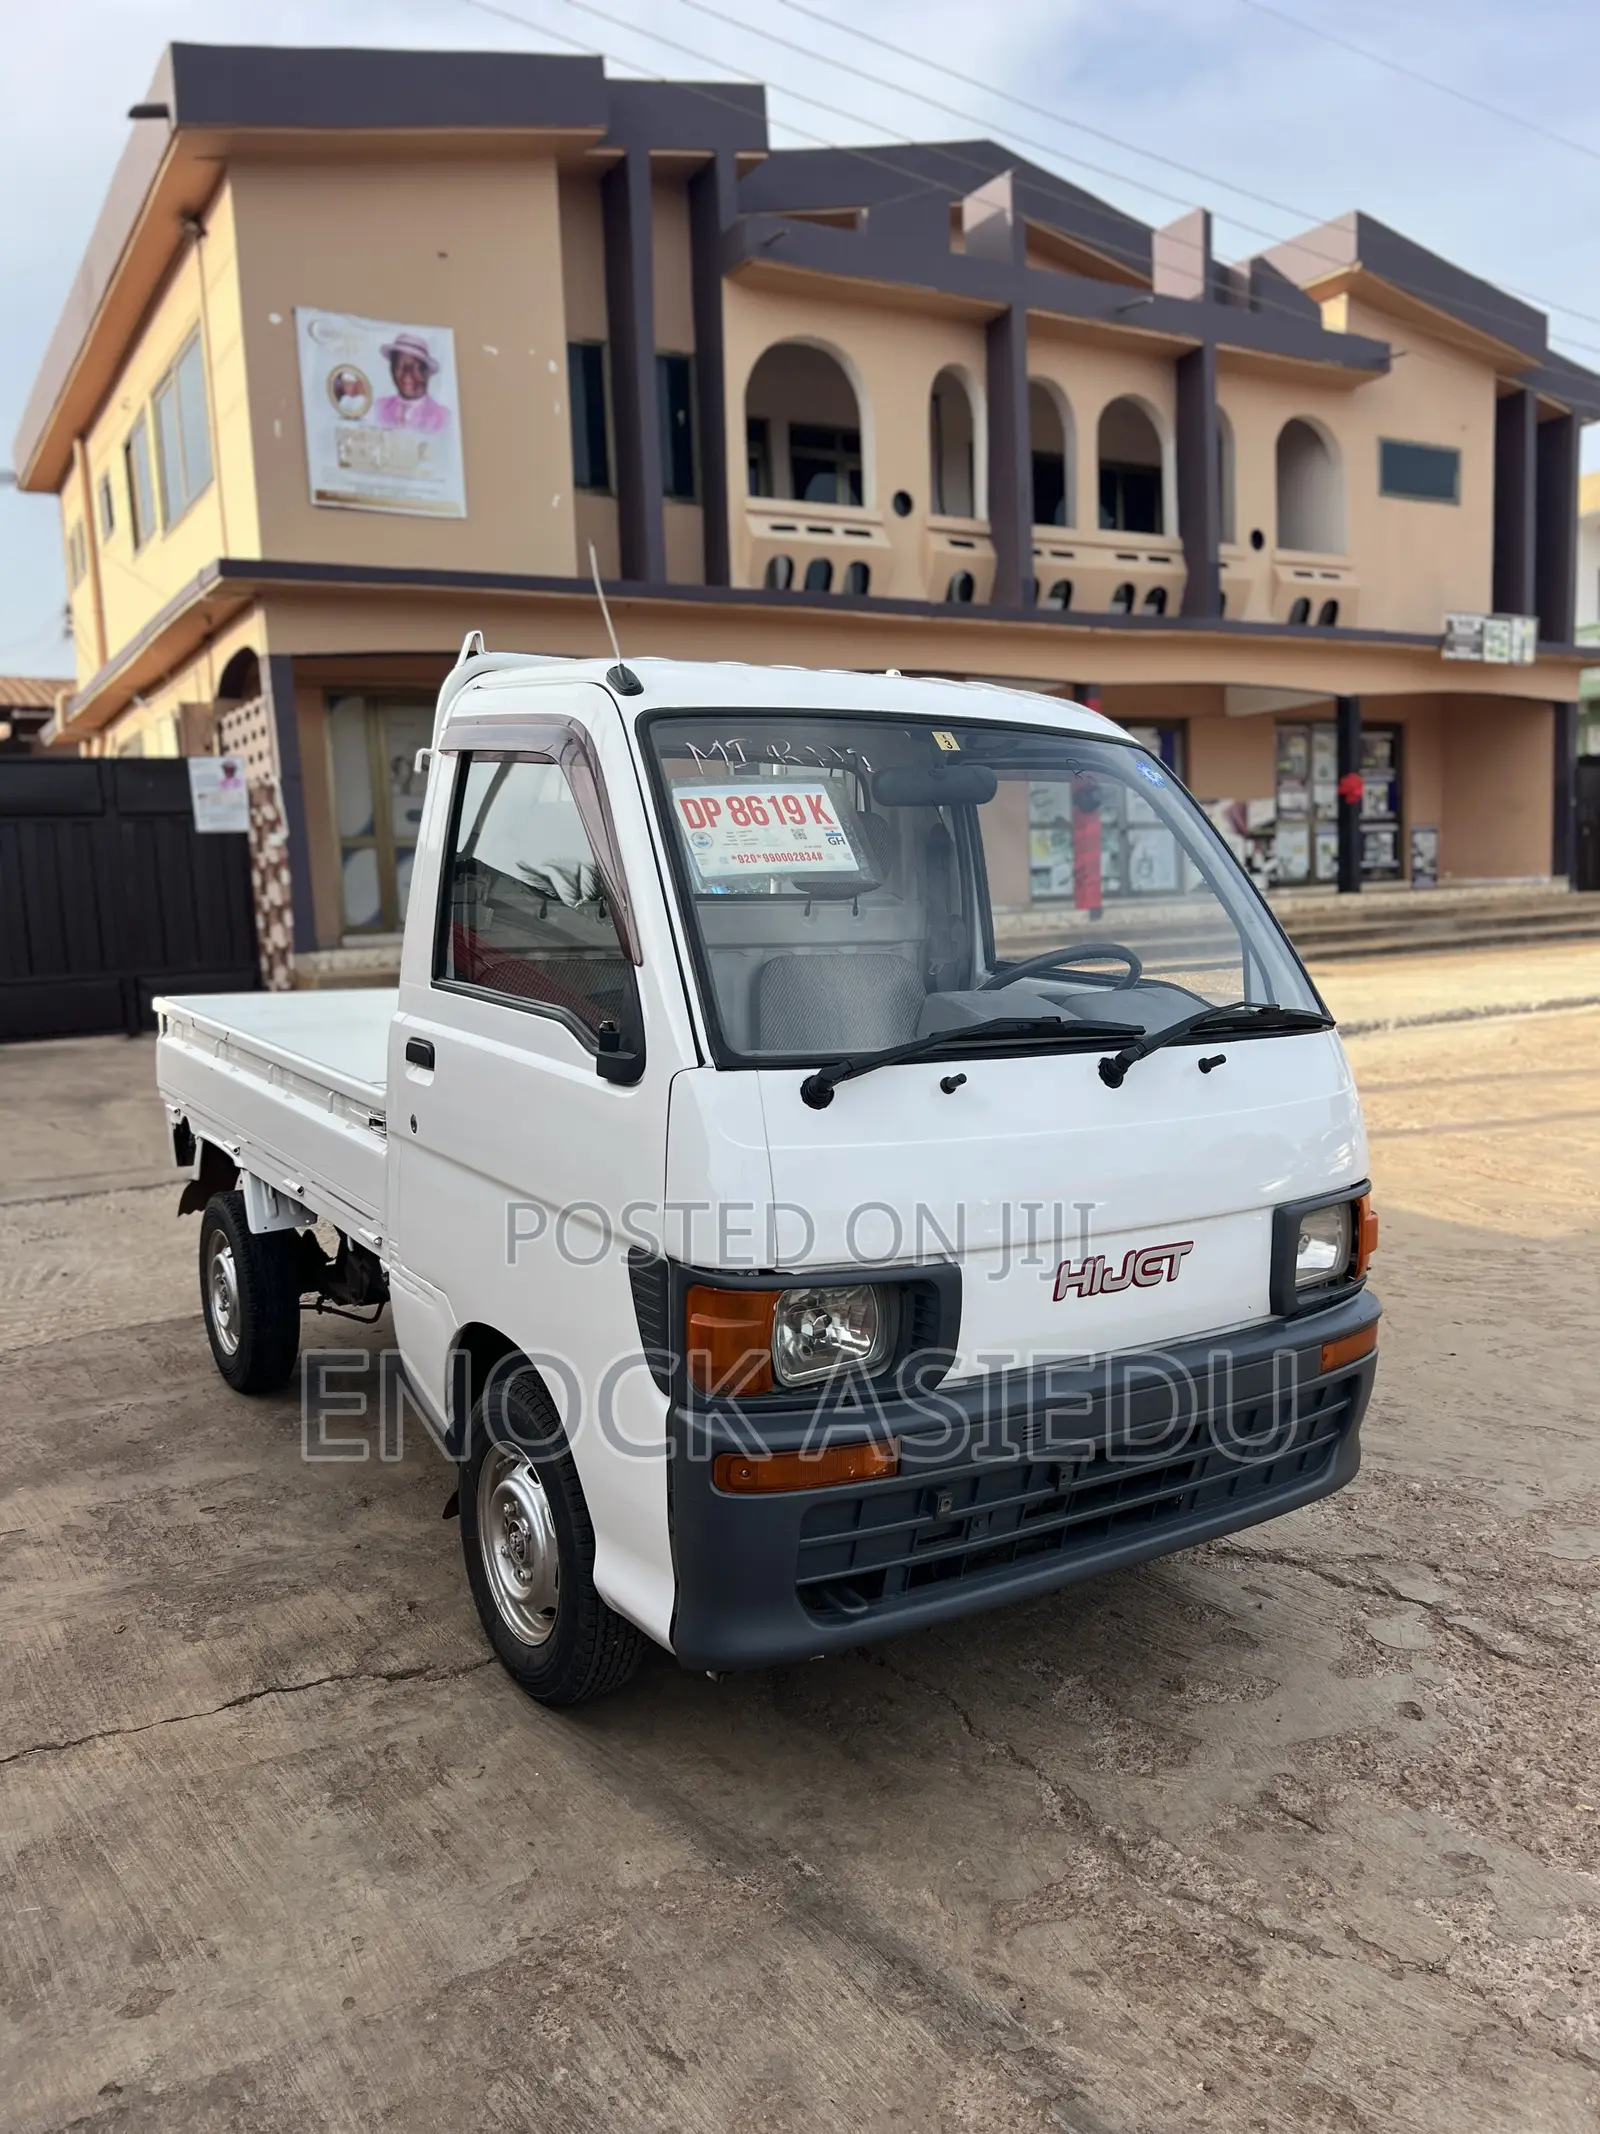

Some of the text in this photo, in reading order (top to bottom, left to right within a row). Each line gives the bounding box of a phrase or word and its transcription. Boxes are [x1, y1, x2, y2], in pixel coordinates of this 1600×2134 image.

[679, 794, 834, 829] DP 8619 K
[827, 836, 846, 846] GH
[1053, 1241, 1194, 1302] HIJET
